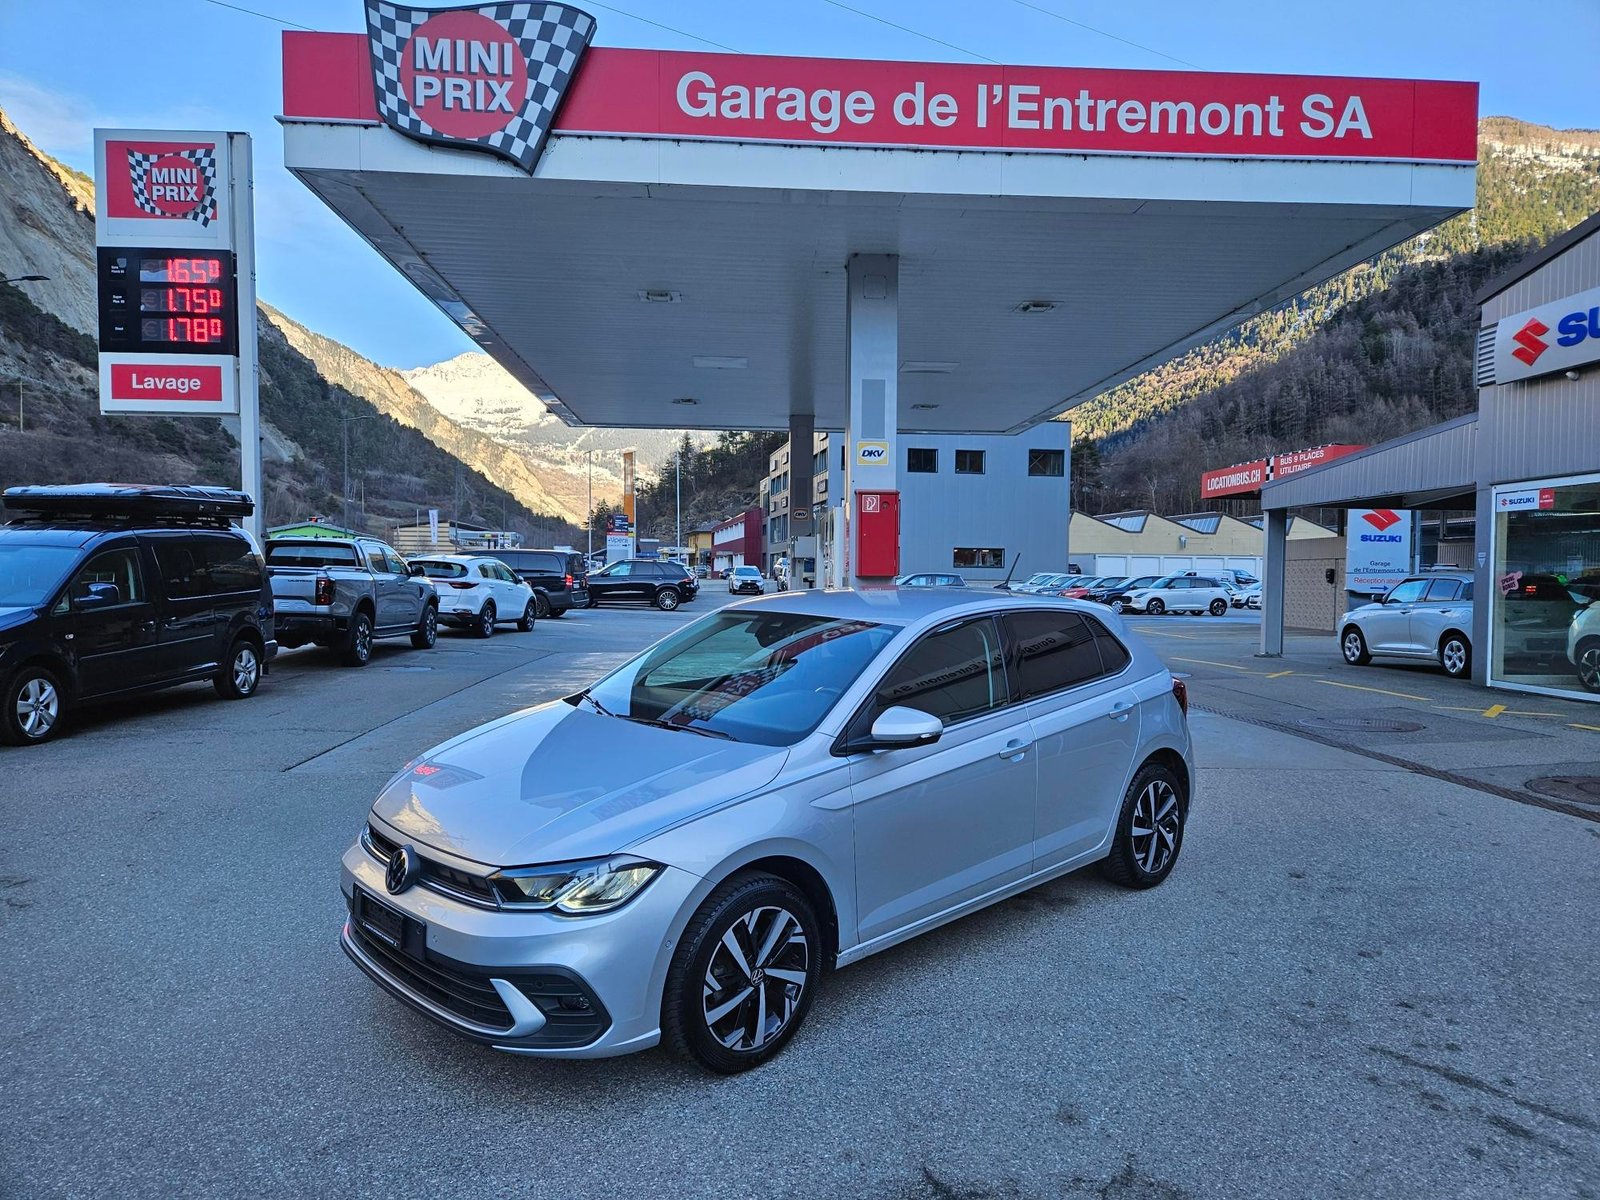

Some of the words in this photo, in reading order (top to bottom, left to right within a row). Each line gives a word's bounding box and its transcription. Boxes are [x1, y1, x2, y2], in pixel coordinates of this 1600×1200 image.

[414, 36, 513, 76] MINI
[414, 75, 515, 114] PRIX
[676, 71, 875, 134] Garage
[893, 81, 959, 127] de
[976, 84, 1285, 137] l'Entremont
[1299, 93, 1374, 140] SA
[151, 167, 198, 185] MINI
[151, 185, 200, 202] PRIX
[132, 373, 201, 394] Lavage
[861, 449, 885, 458] DKV
[1280, 457, 1293, 466] BUS
[1294, 455, 1298, 463] 9
[1300, 449, 1325, 462] PLACES
[1207, 468, 1261, 491] LOCATIONBUS.CH
[1508, 497, 1535, 505] SUZUKI
[1360, 534, 1402, 543] SUZUKI
[1369, 560, 1391, 568] Garage
